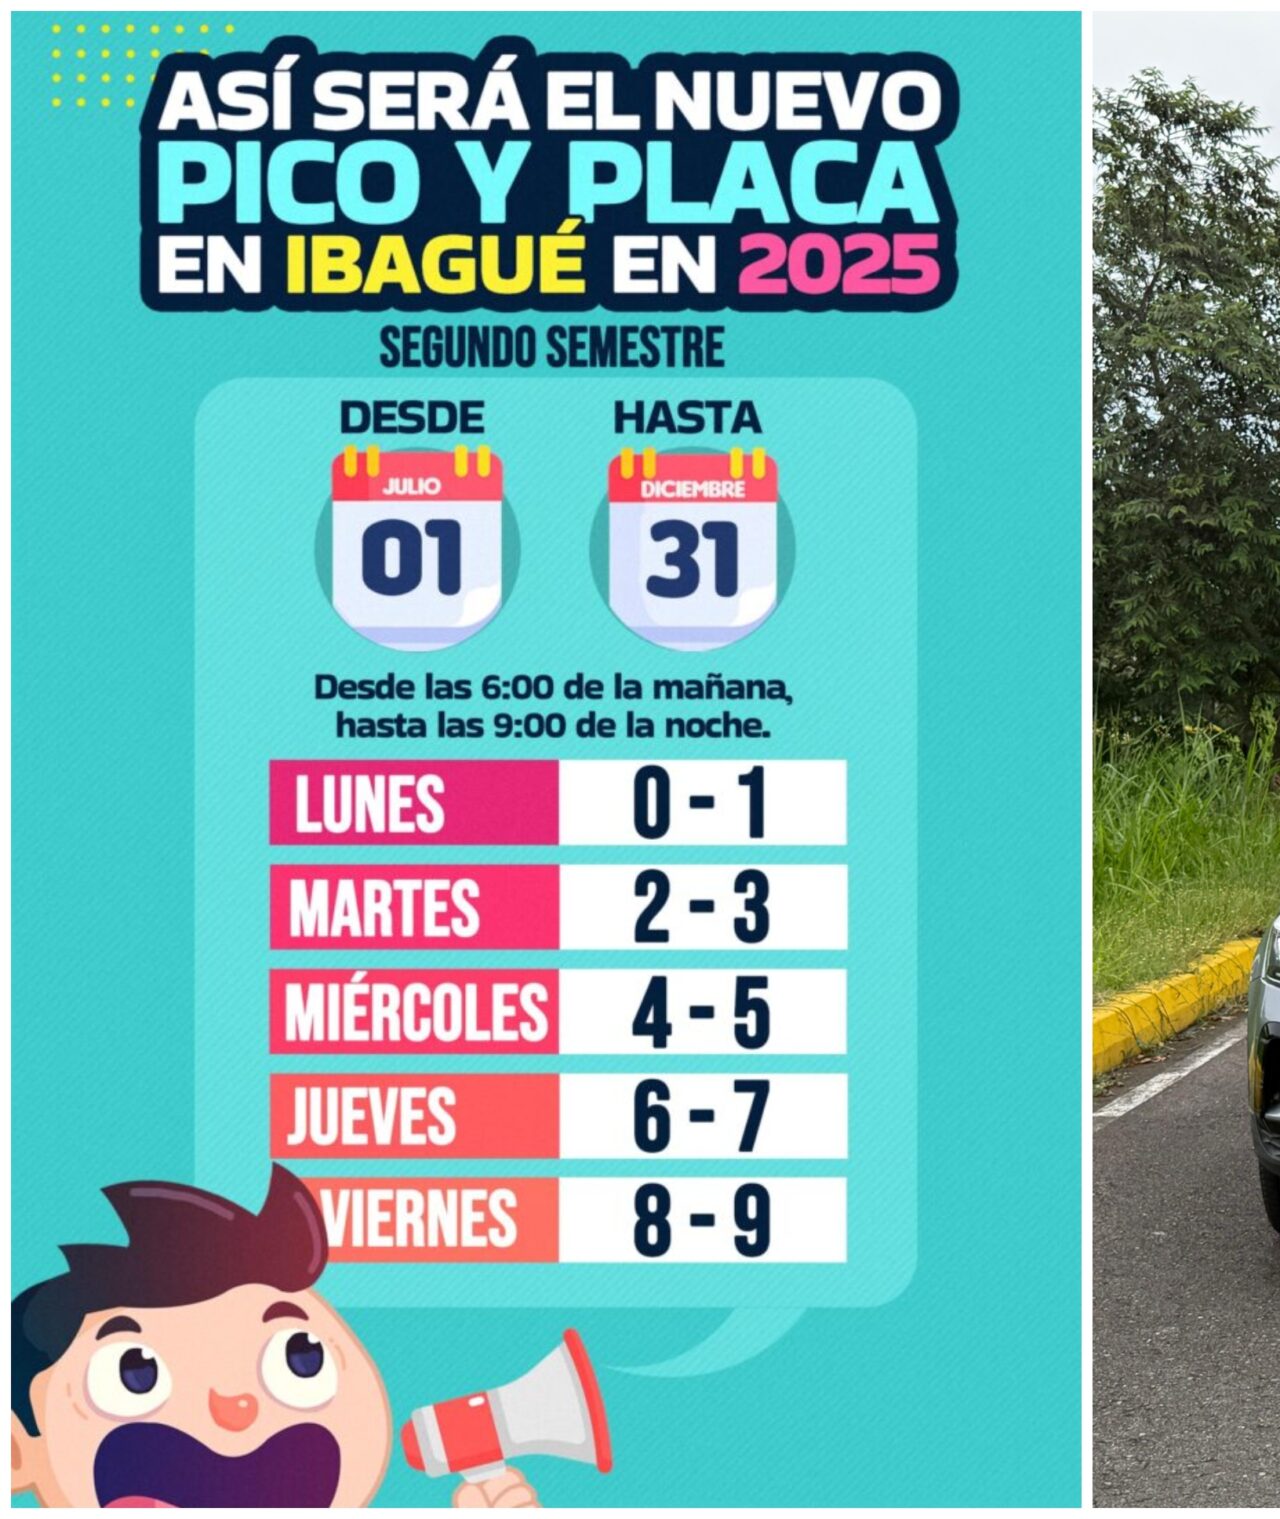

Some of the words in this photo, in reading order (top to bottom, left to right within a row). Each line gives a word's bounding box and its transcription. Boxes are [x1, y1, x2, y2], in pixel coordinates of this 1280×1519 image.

[158, 55, 298, 131] ASÍ
[313, 55, 530, 131] SERÁ
[547, 71, 641, 131] EL
[656, 71, 942, 131] NUEVO
[158, 140, 420, 225] PICO
[455, 141, 531, 223] Y
[568, 140, 939, 225] PLACA
[159, 236, 261, 293] EN
[287, 218, 586, 294] IBAGUÉ
[614, 236, 717, 293] EN
[738, 234, 940, 294] 2025
[380, 325, 537, 368] SEGUNDO
[547, 325, 725, 368] SEMESTRE
[340, 400, 485, 434] DESDE
[614, 400, 763, 434] HASTA
[382, 477, 442, 495] JULIO
[641, 479, 746, 498] DICIEMBRE
[361, 518, 462, 596] 01
[646, 519, 739, 598] 31
[315, 673, 416, 700] Desde
[425, 673, 473, 700] las
[481, 674, 554, 700] 6:00
[563, 673, 604, 700] de
[614, 673, 643, 700] la
[653, 673, 793, 706] mañana,
[336, 711, 427, 738] hasta
[438, 711, 485, 738] las
[493, 712, 567, 738] 9:00
[576, 711, 617, 738] de
[626, 711, 655, 738] la
[665, 711, 771, 738] noche.
[296, 775, 445, 832] LUNES
[634, 766, 670, 839] 0
[690, 796, 714, 809] -
[738, 766, 764, 839] 1
[290, 879, 480, 937] MARTES
[634, 870, 670, 943] 2
[690, 900, 714, 913] -
[734, 870, 769, 943] 3
[285, 972, 548, 1042] MIÉRCOLES
[632, 976, 672, 1049] 4
[690, 1006, 714, 1019] -
[734, 976, 770, 1049] 5
[287, 1087, 456, 1145] JUEVES
[634, 1079, 670, 1153] 6
[690, 1110, 714, 1123] -
[734, 1080, 770, 1152] 7
[320, 1188, 518, 1248] VIERNES
[634, 1184, 671, 1258] 8
[690, 1214, 714, 1227] -
[734, 1184, 770, 1258] 9
